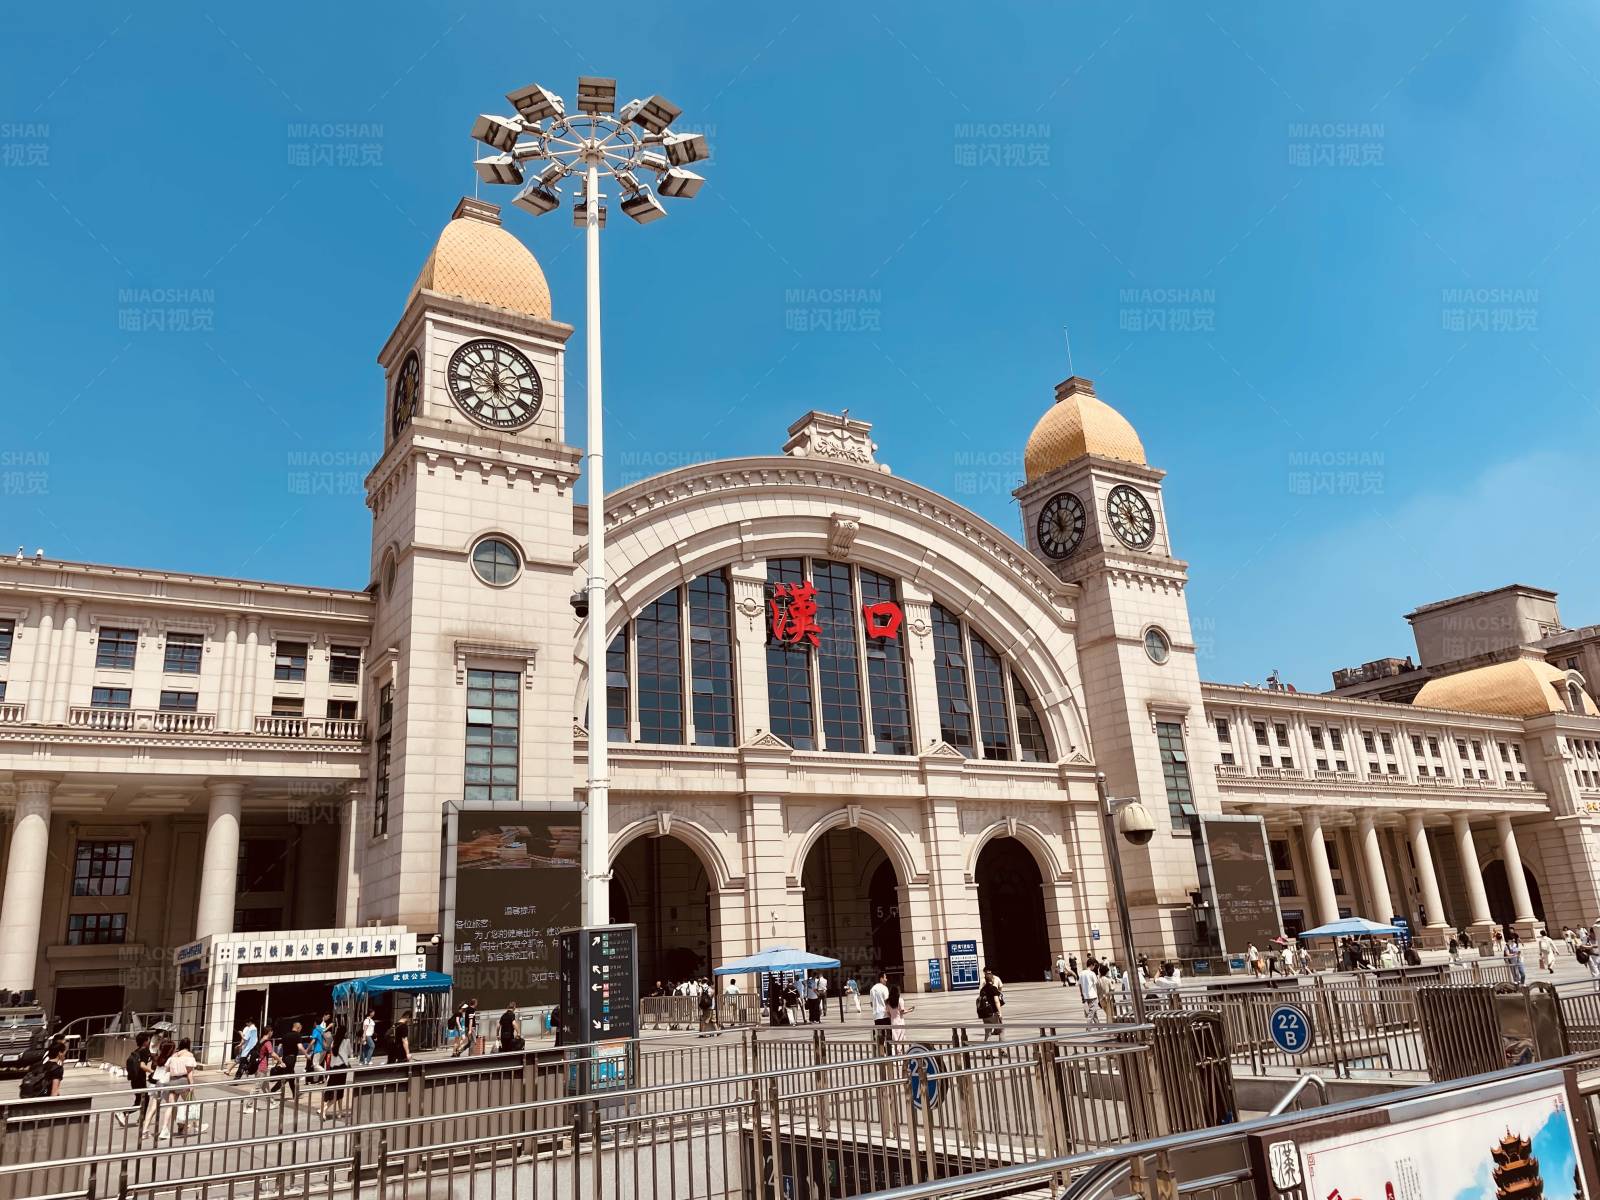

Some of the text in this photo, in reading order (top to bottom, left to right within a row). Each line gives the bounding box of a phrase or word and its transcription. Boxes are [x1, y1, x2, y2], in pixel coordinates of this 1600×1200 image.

[236, 937, 398, 960] 武汉铁路公安警务服务岗
[392, 972, 428, 982] 武铁公安
[1277, 1014, 1299, 1029] 22
[1285, 1031, 1297, 1046] B
